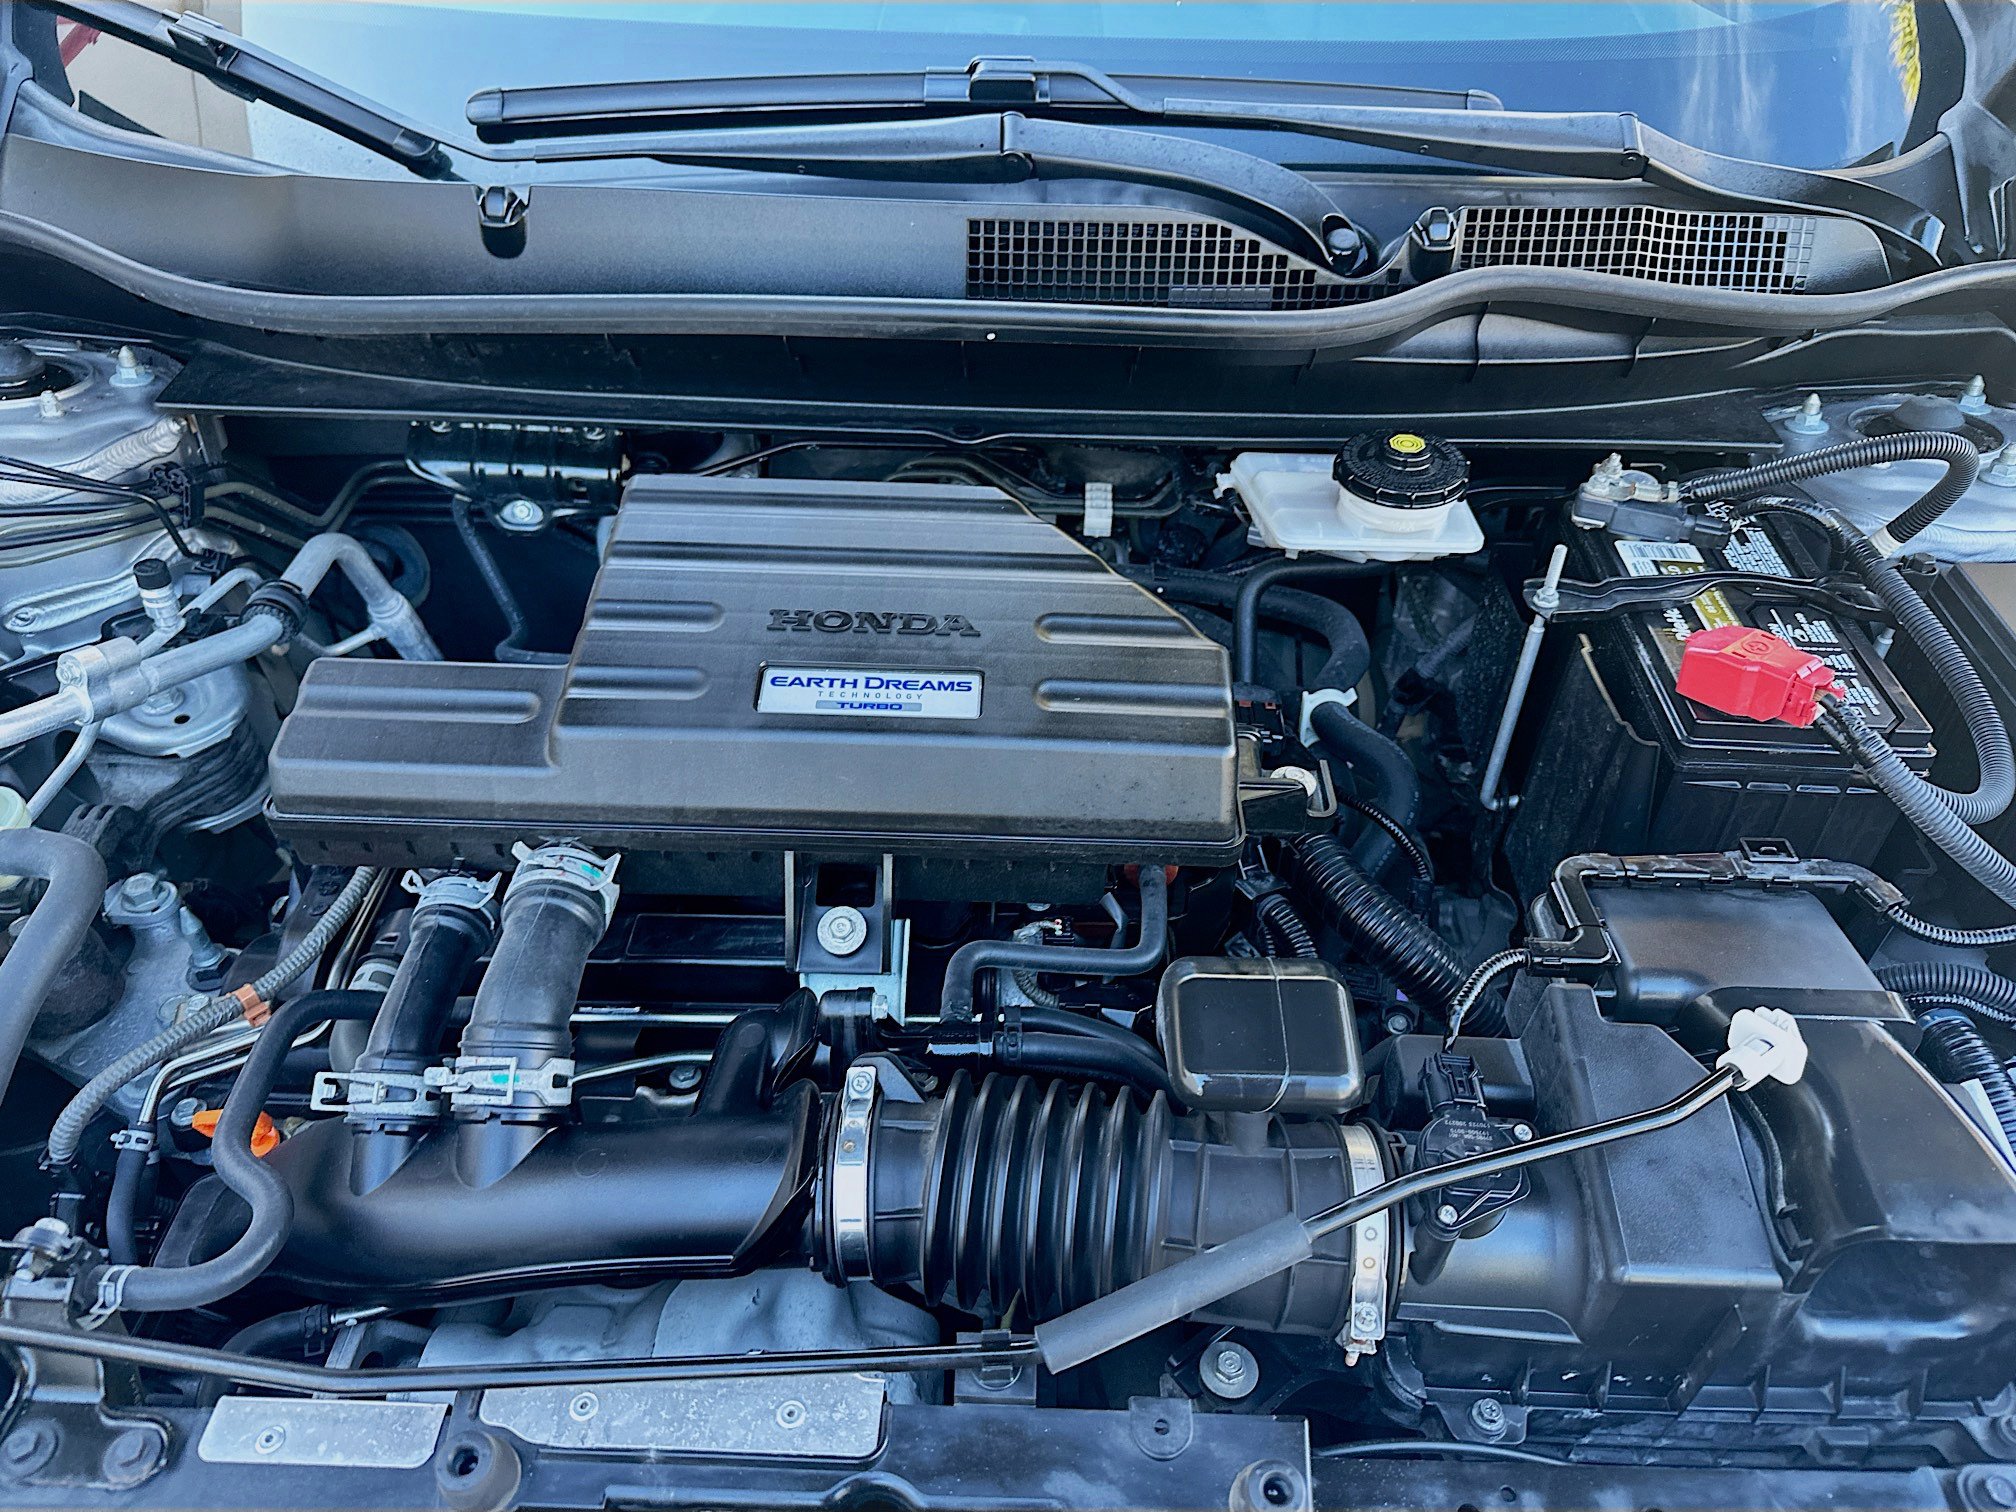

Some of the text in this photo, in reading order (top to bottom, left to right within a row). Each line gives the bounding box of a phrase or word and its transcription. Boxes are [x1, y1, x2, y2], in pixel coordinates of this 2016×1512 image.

[767, 608, 981, 637] HONDA
[770, 676, 972, 691] EARTH DREAMS
[818, 690, 923, 700] TECHNOLOGY
[836, 702, 903, 711] TURBO
